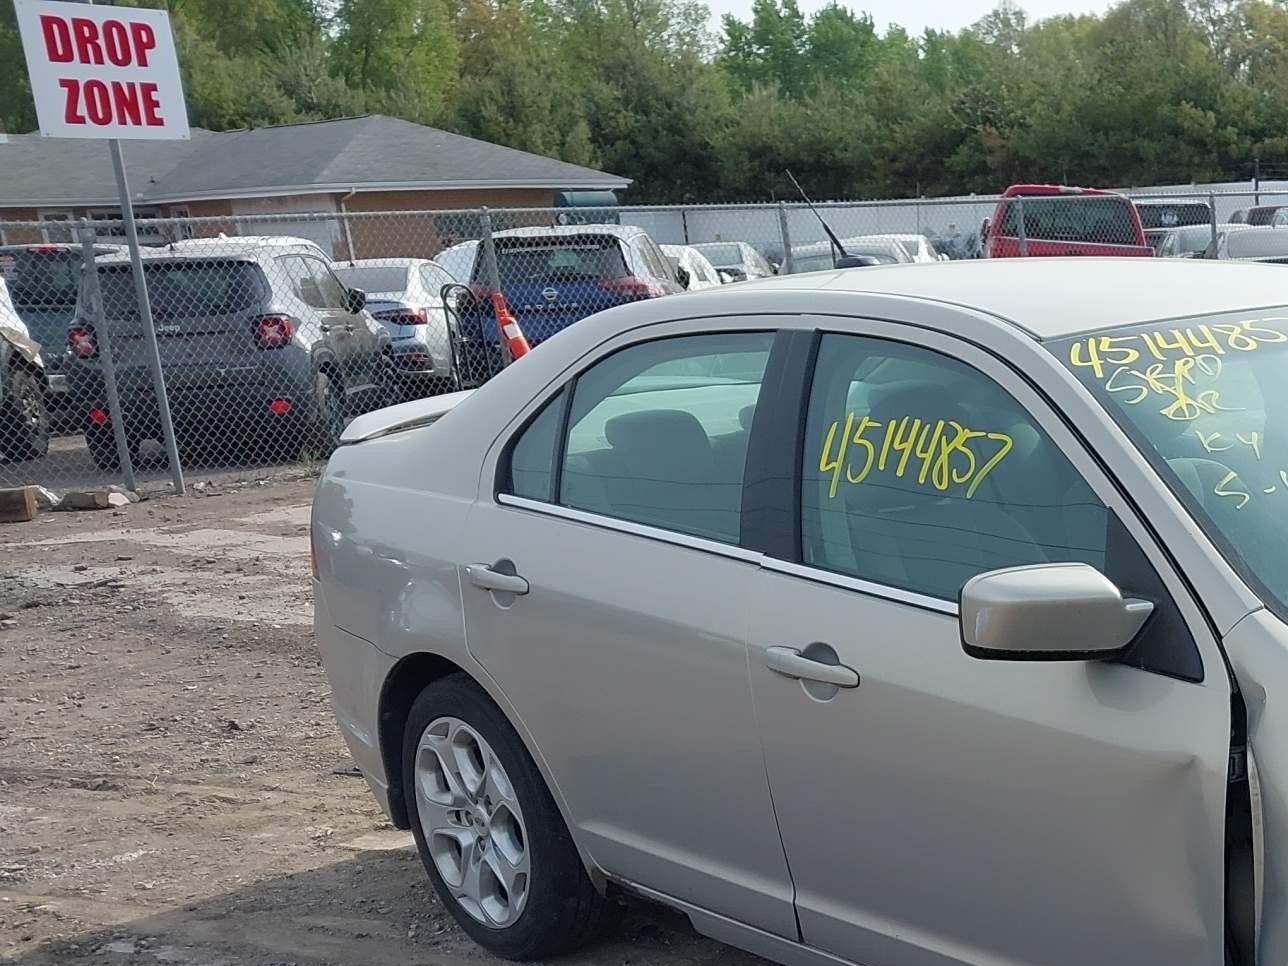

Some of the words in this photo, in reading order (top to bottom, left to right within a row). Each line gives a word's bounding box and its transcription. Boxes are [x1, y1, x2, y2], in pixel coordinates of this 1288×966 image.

[40, 15, 156, 67] DROP
[58, 78, 165, 126] ZONE
[819, 412, 1013, 499] 45144857
